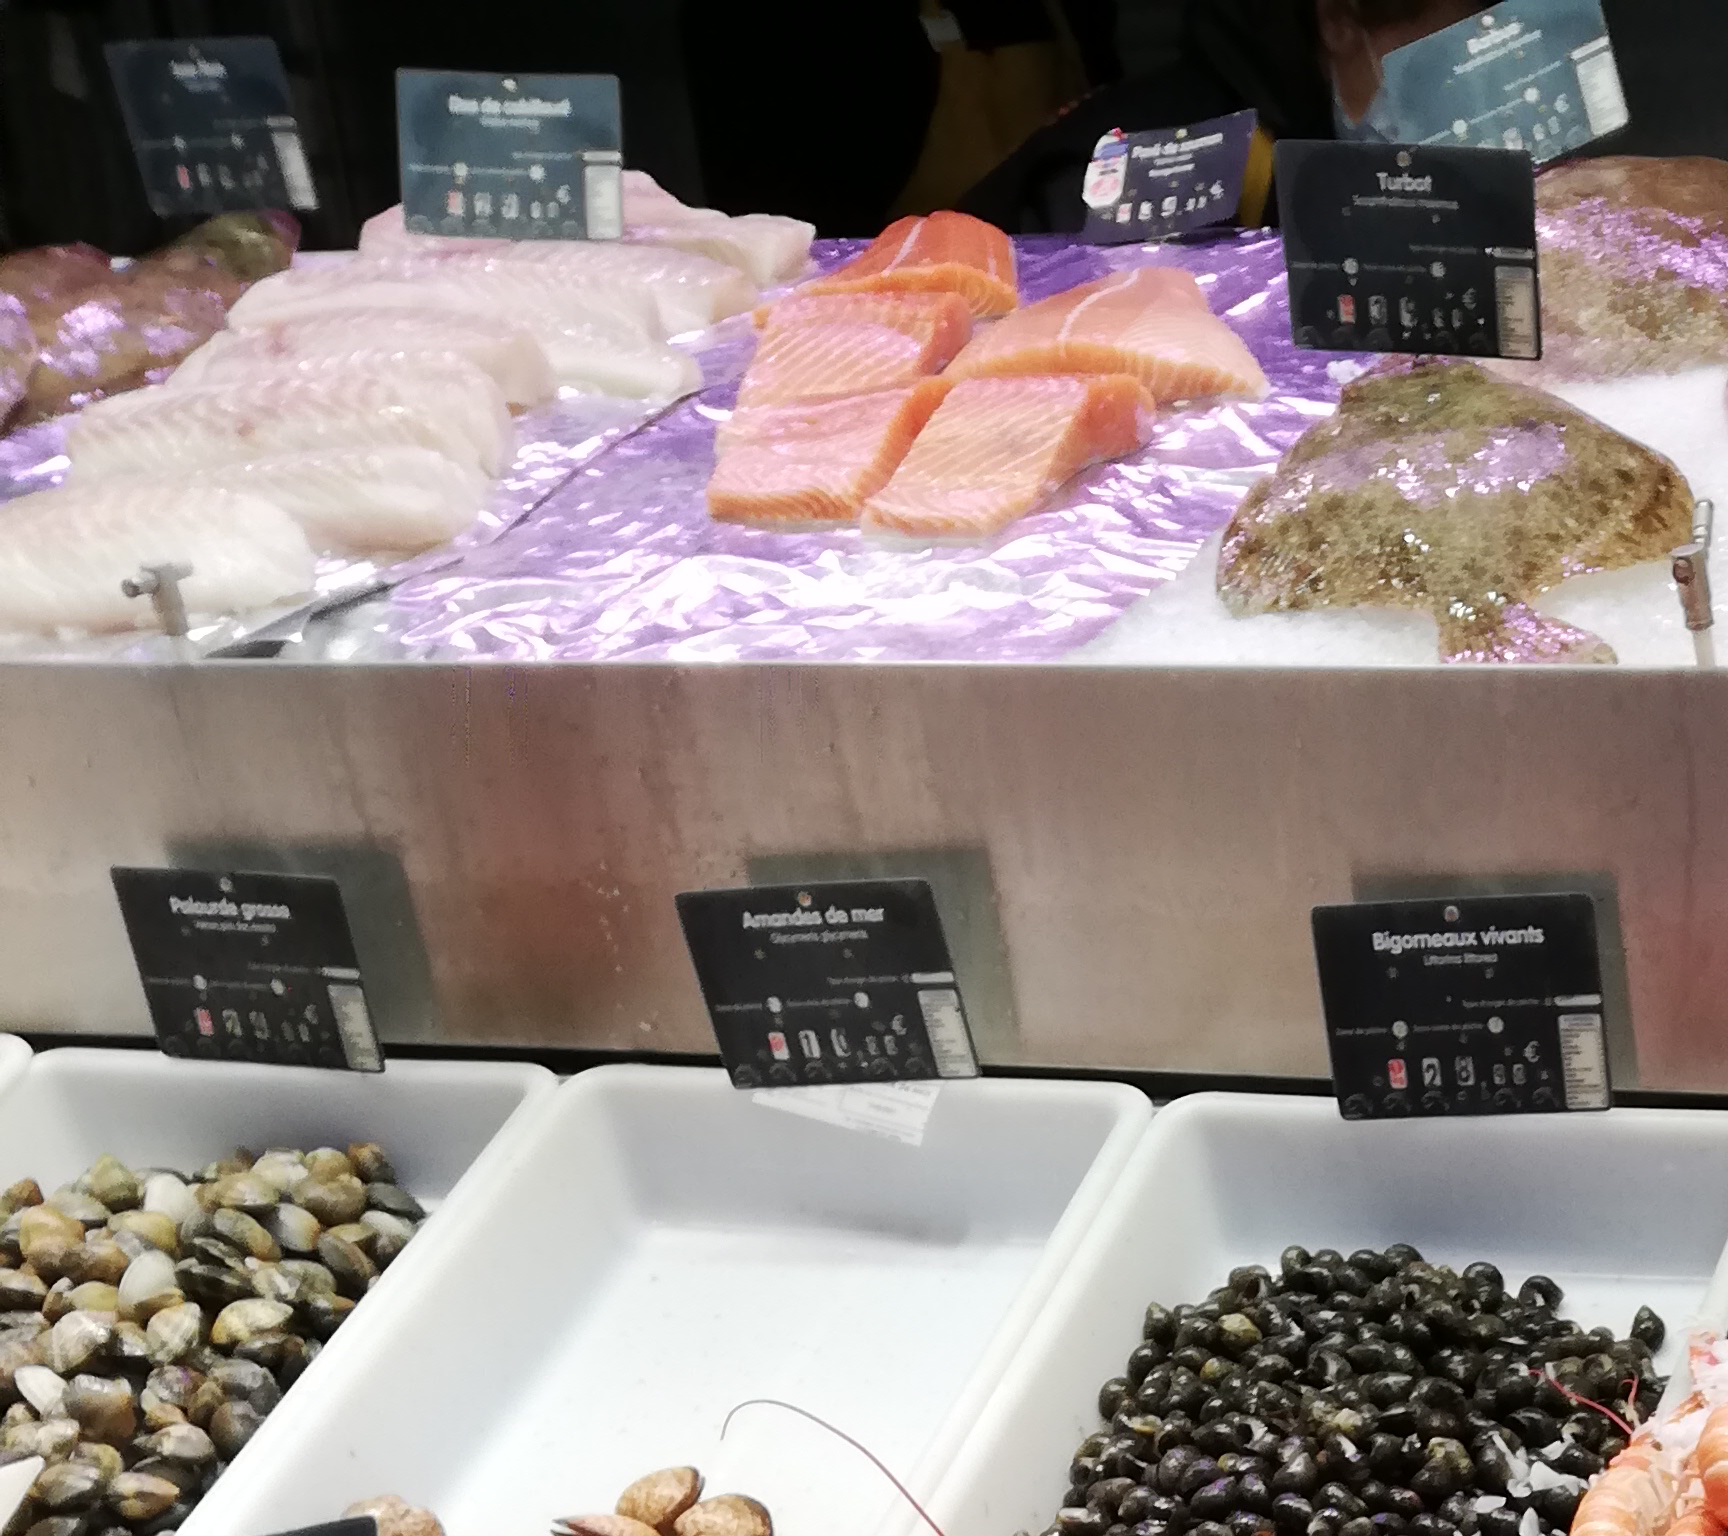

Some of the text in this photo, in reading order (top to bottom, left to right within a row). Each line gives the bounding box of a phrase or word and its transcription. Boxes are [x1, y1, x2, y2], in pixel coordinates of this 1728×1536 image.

[1376, 171, 1433, 193] Turbot
[1372, 925, 1545, 955] Bigorneaux vivants
